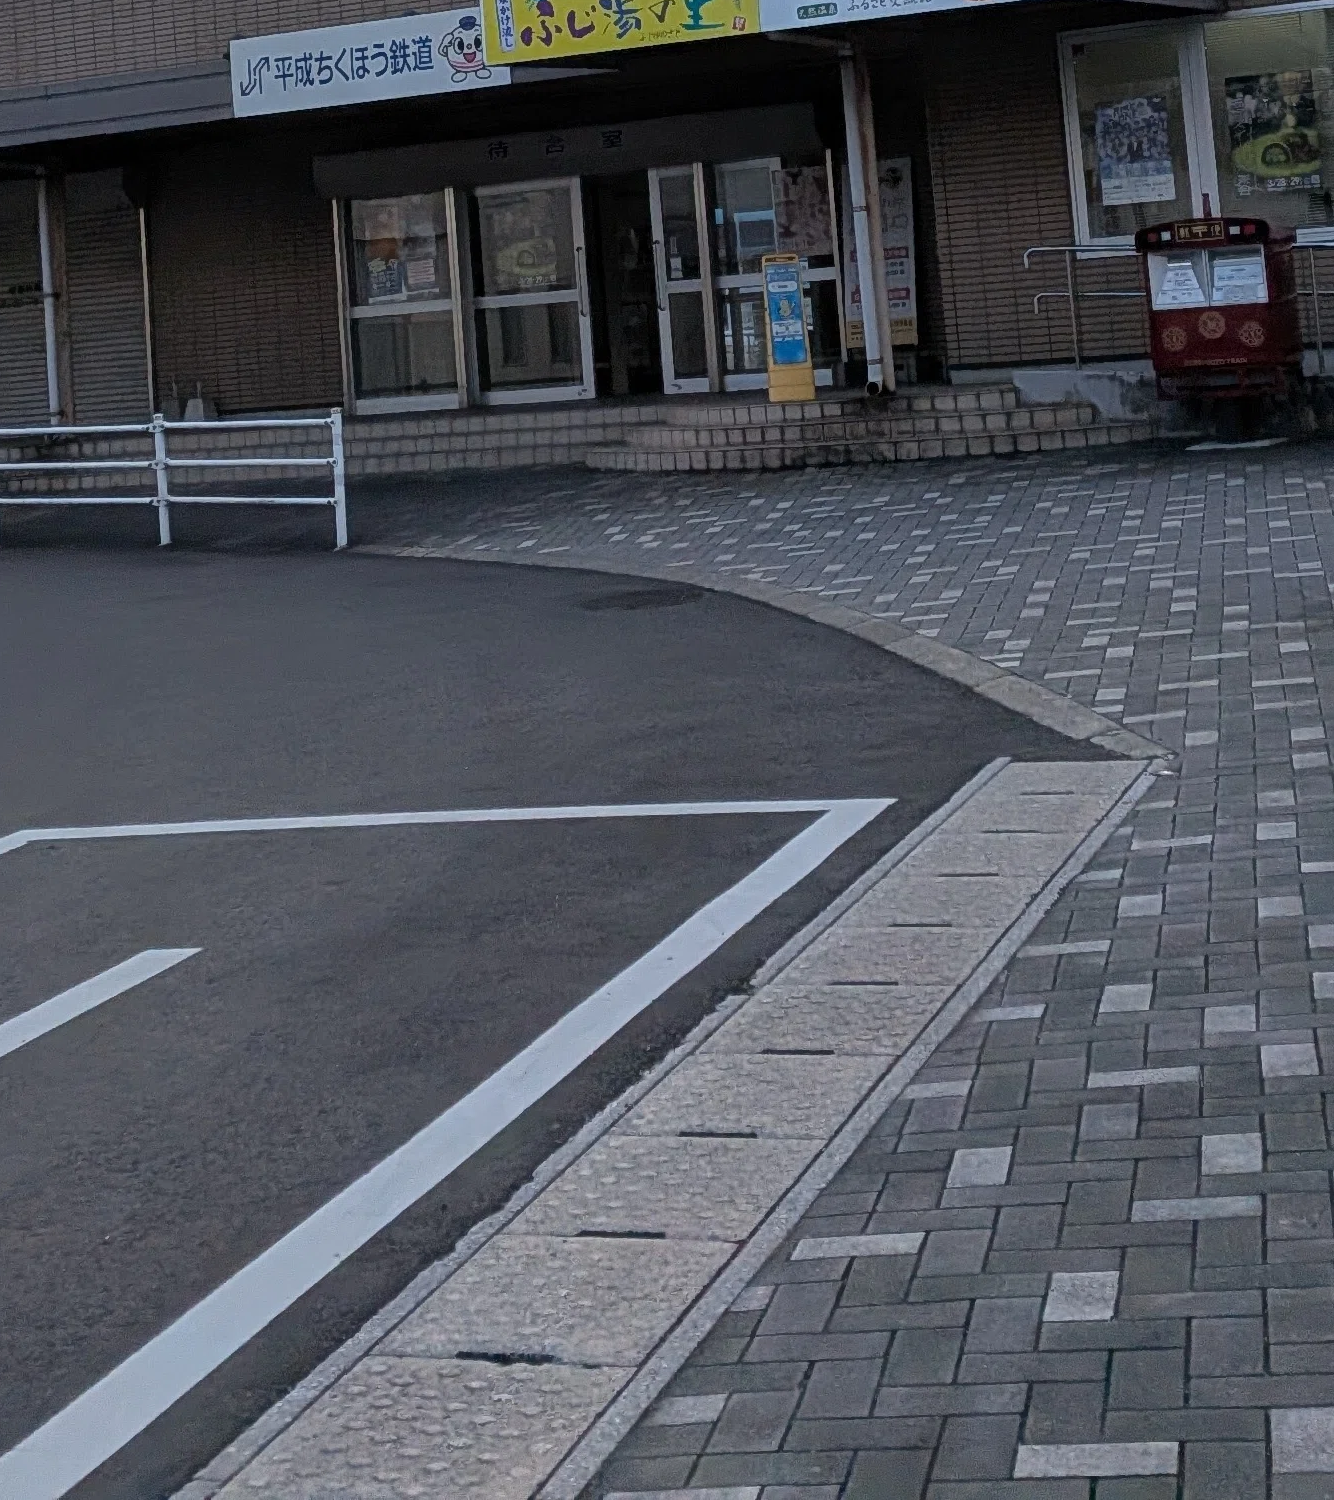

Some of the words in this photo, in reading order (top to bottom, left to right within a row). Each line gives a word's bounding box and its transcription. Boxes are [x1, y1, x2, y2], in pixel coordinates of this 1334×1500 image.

[798, 5, 837, 19] 天然温泉
[274, 35, 434, 92] 平成ちくほう鉄道
[487, 129, 623, 161] 待合室
